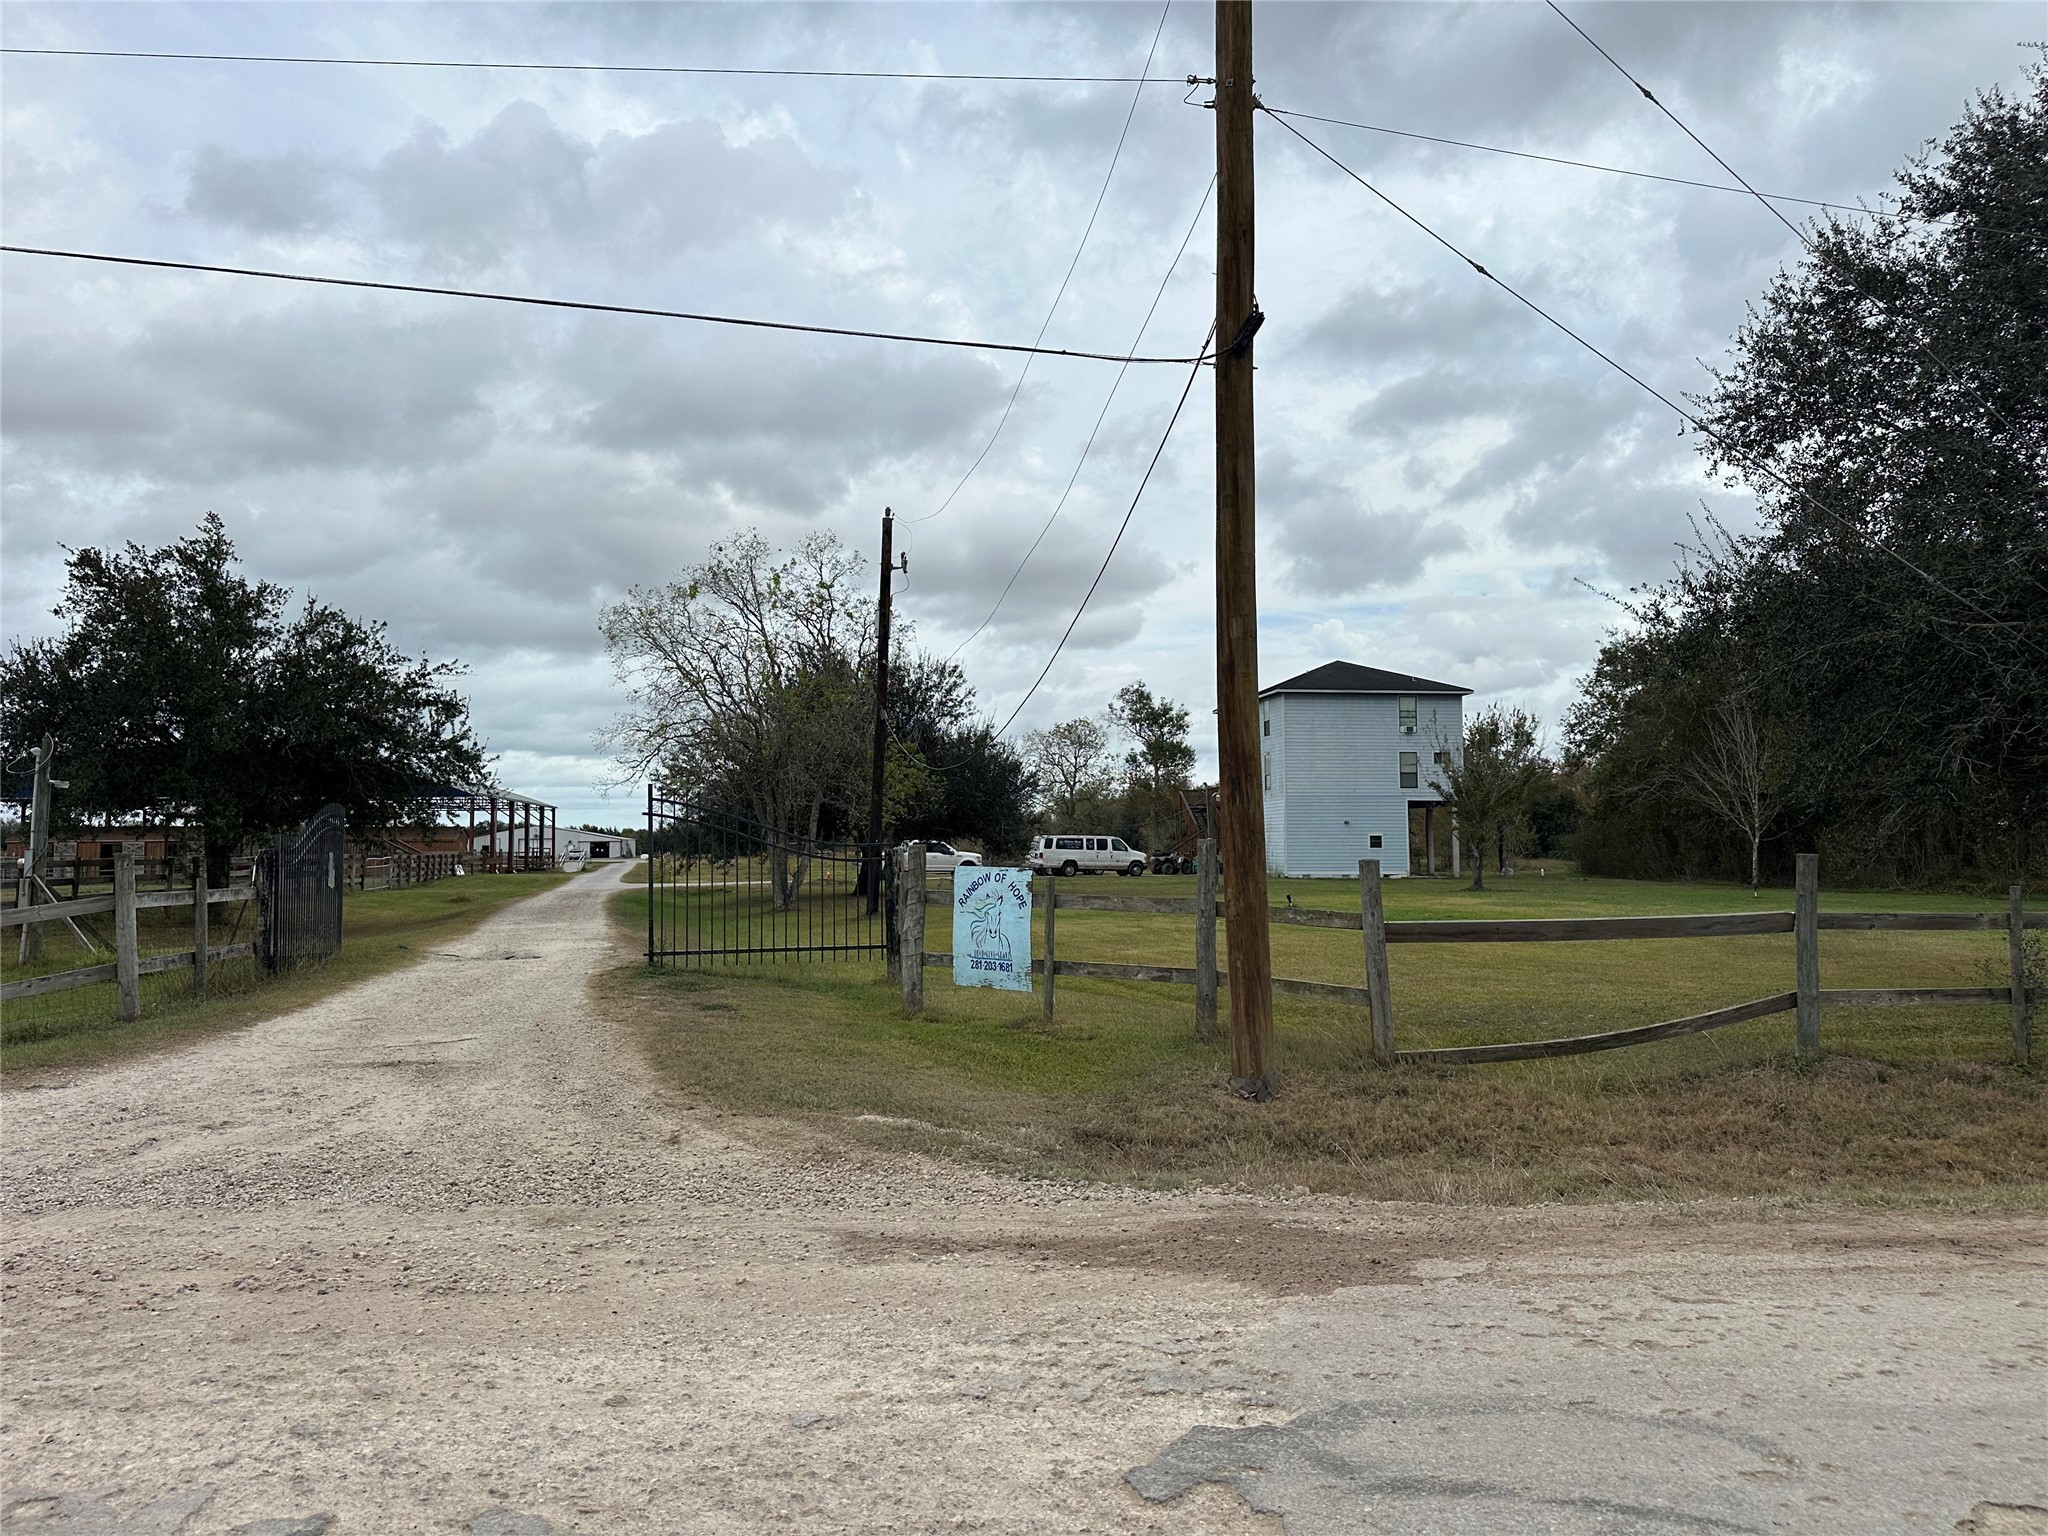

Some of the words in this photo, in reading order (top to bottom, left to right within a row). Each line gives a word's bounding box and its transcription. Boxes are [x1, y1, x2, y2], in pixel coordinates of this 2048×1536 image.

[958, 872, 991, 907] RAINBOW
[994, 872, 1007, 883] OF
[1008, 881, 1028, 909] HOPE
[970, 959, 1013, 973] 281-203-1681
